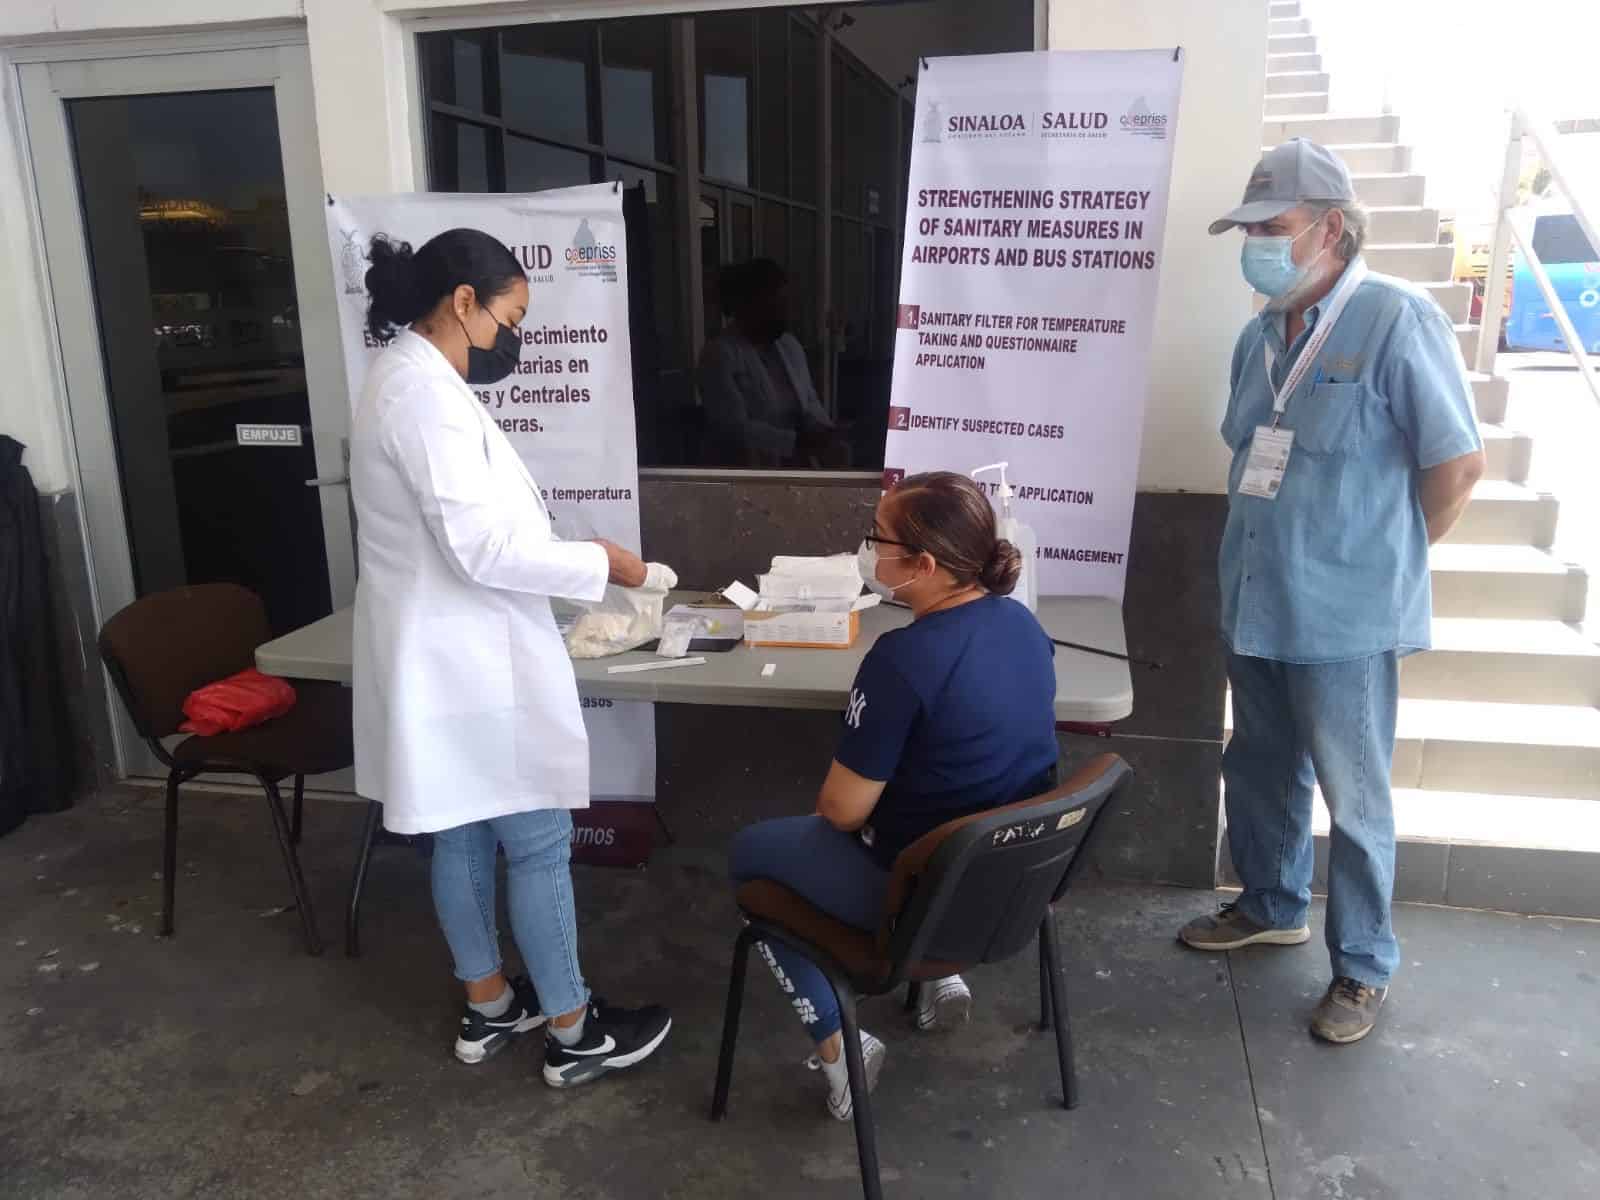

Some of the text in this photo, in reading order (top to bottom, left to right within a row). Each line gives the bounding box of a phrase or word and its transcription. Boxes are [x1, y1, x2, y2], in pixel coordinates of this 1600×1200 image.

[948, 114, 1025, 132] SINALOA
[1042, 112, 1108, 129] SALUD
[918, 189, 1150, 210] STRENGTHENING STRATEGY
[919, 217, 1143, 240] OF SANITARY MEASURES IN
[565, 242, 616, 261] coepriss
[912, 245, 1155, 269] AIRPORTS AND BUS STATIONS
[920, 312, 972, 328] SANITARY
[975, 314, 1013, 330] FILTER
[1016, 316, 1038, 331] FOR
[1041, 317, 1127, 334] TEMPERATURE
[519, 324, 607, 345] lecimiento
[918, 332, 1078, 353] TAKING AND QUESTIONNAIRE
[568, 358, 589, 373] en
[915, 353, 985, 370] APPLICATION
[495, 390, 505, 408] y
[510, 385, 591, 404] Centrales
[242, 428, 297, 441] EMPUJE
[911, 414, 959, 431] IDENTIFY
[962, 418, 1025, 436] SUSPECTED
[1028, 422, 1064, 439] CASES
[552, 487, 632, 503] temperatura
[1018, 486, 1094, 505] APPLICATION
[1043, 547, 1124, 564] MANAGEMENT
[580, 696, 613, 708] asos
